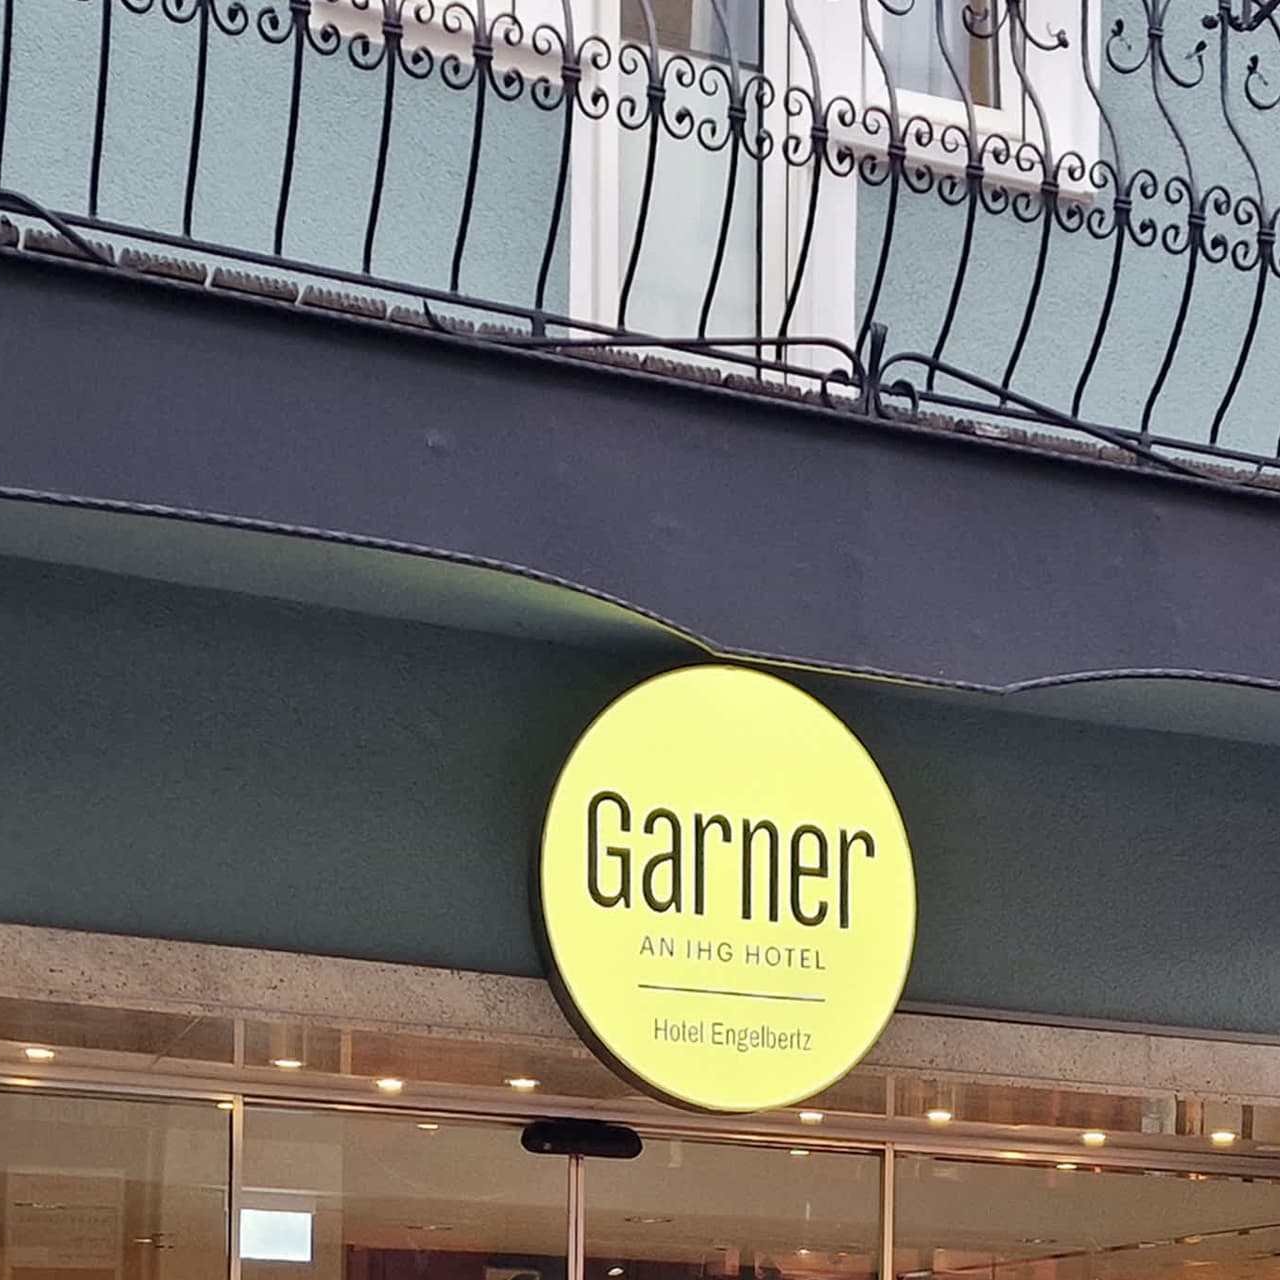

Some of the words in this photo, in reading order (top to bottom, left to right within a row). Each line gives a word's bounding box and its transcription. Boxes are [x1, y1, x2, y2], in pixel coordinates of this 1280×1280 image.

[587, 790, 875, 929] Garner
[639, 935, 675, 957] AN
[686, 939, 733, 962] IHG
[745, 944, 826, 970] HOTEL
[654, 1018, 704, 1044] Hotel
[711, 1022, 812, 1053] Engelbertz
